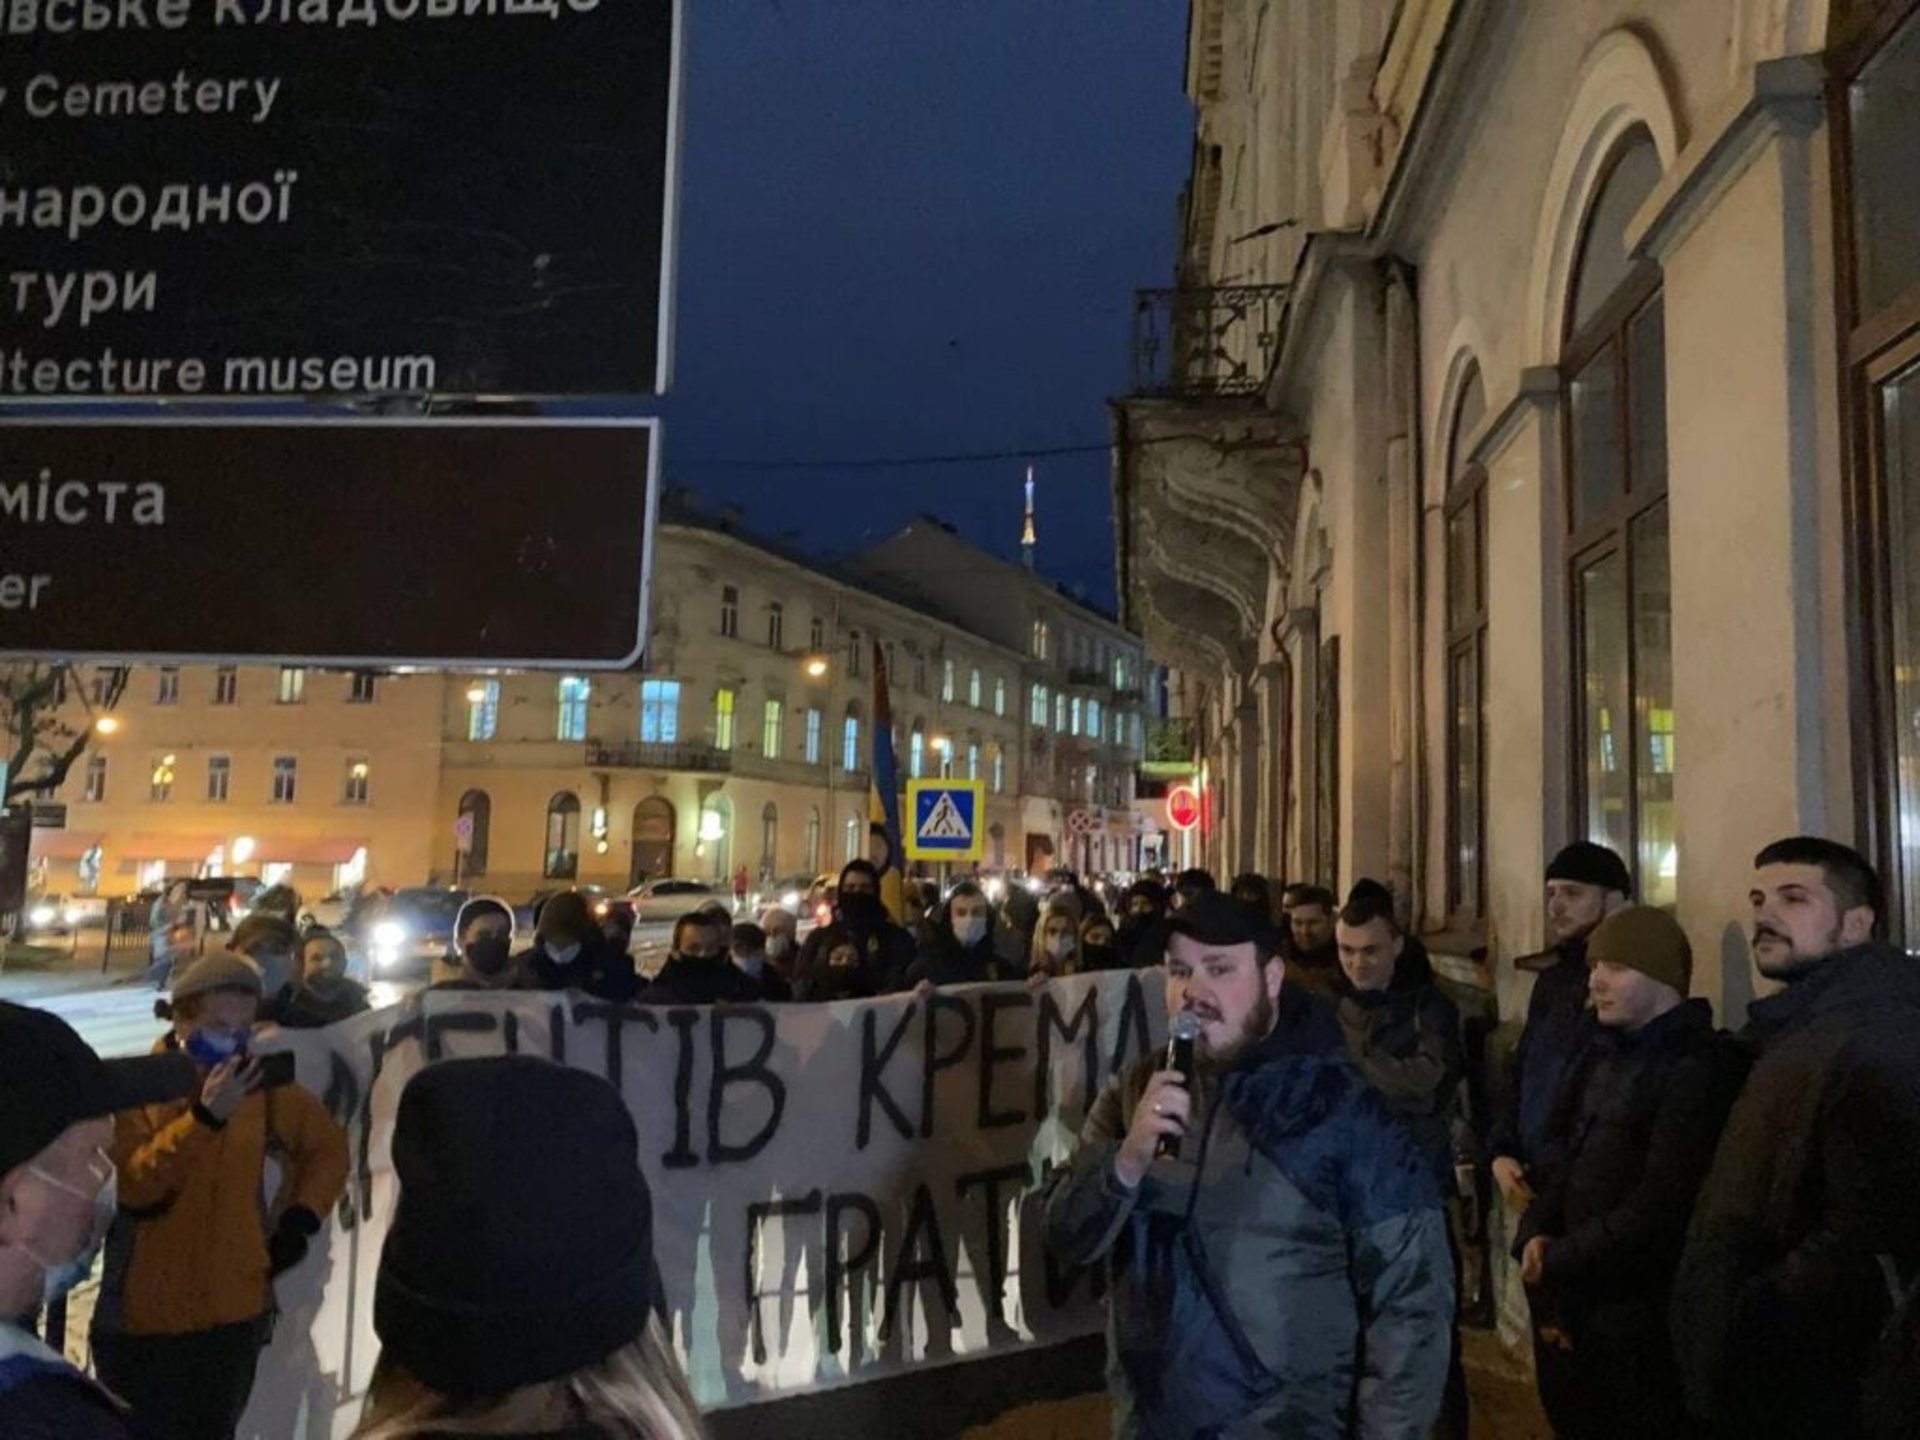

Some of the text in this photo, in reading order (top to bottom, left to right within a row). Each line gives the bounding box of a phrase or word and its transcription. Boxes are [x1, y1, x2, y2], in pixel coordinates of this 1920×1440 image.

[25, 67, 281, 123] Cemetery
[0, 169, 298, 241] народної
[8, 269, 158, 328] тури
[224, 353, 437, 393] museum
[0, 466, 166, 525] міста
